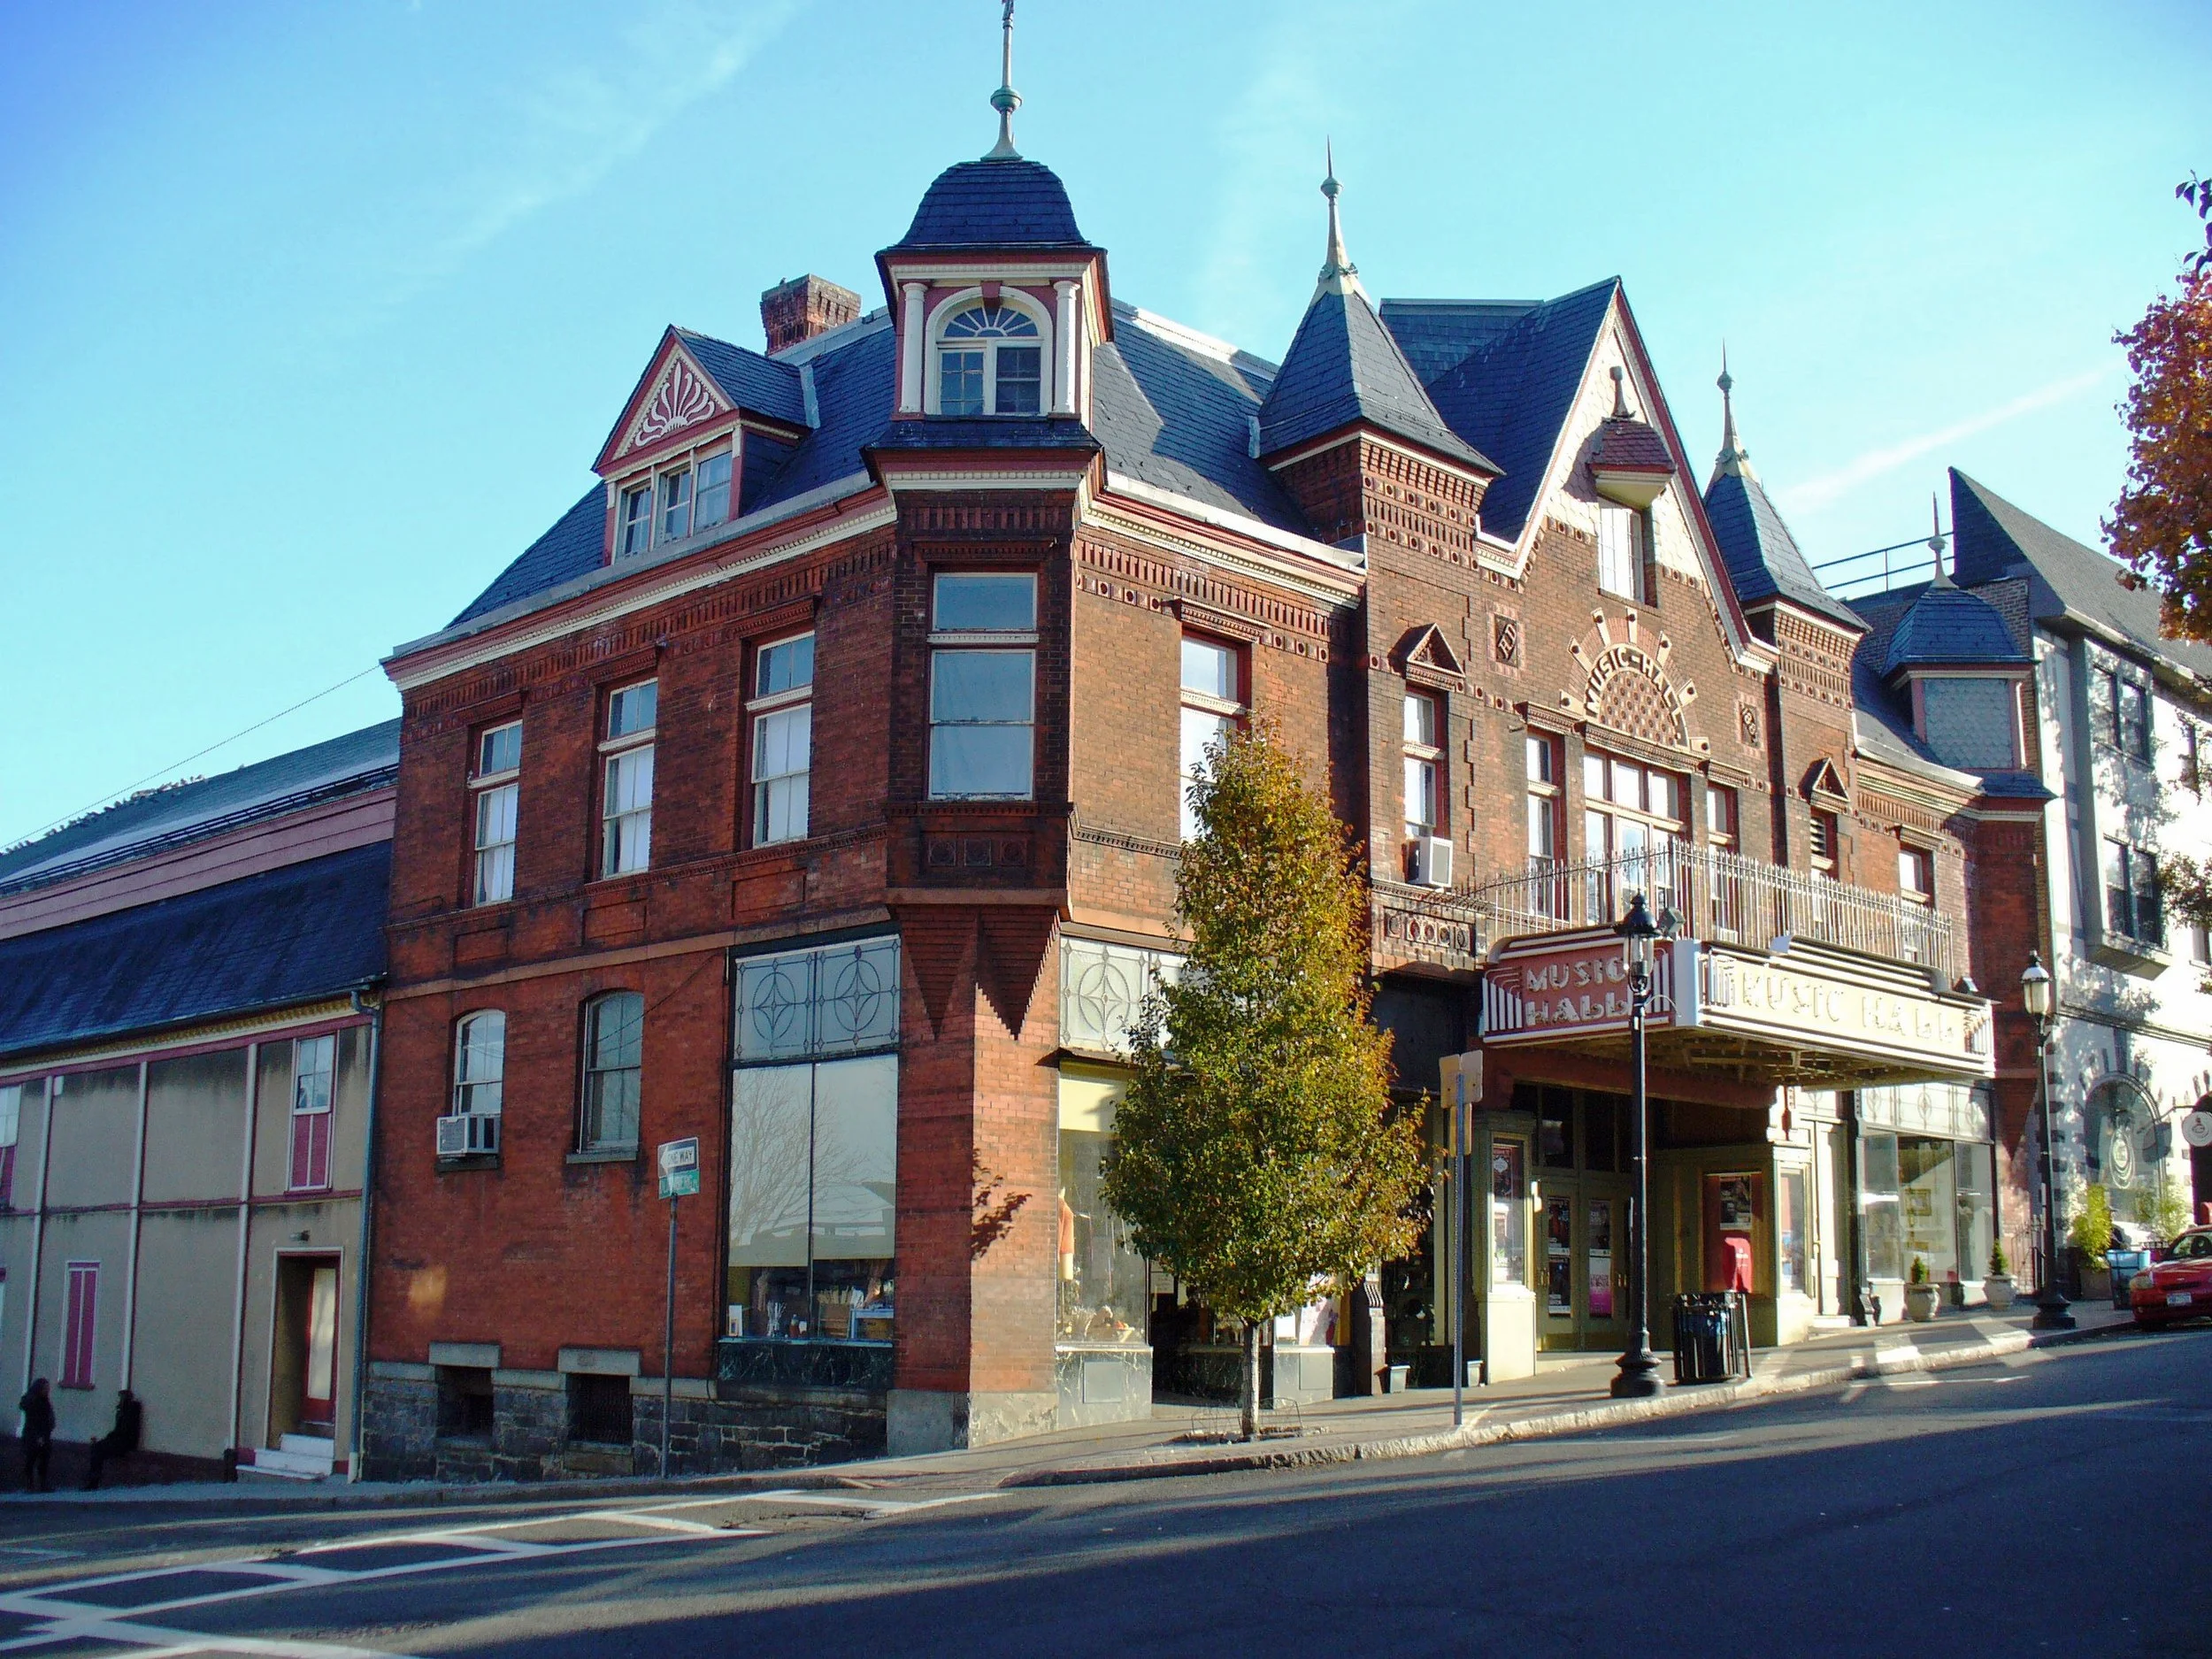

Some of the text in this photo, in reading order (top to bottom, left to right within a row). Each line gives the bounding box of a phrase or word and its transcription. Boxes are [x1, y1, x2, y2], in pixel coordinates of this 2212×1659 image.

[1526, 956, 1626, 992] MUSIC
[1525, 992, 1629, 1026] HALL
[1742, 971, 1955, 1043] MUSIC HALL
